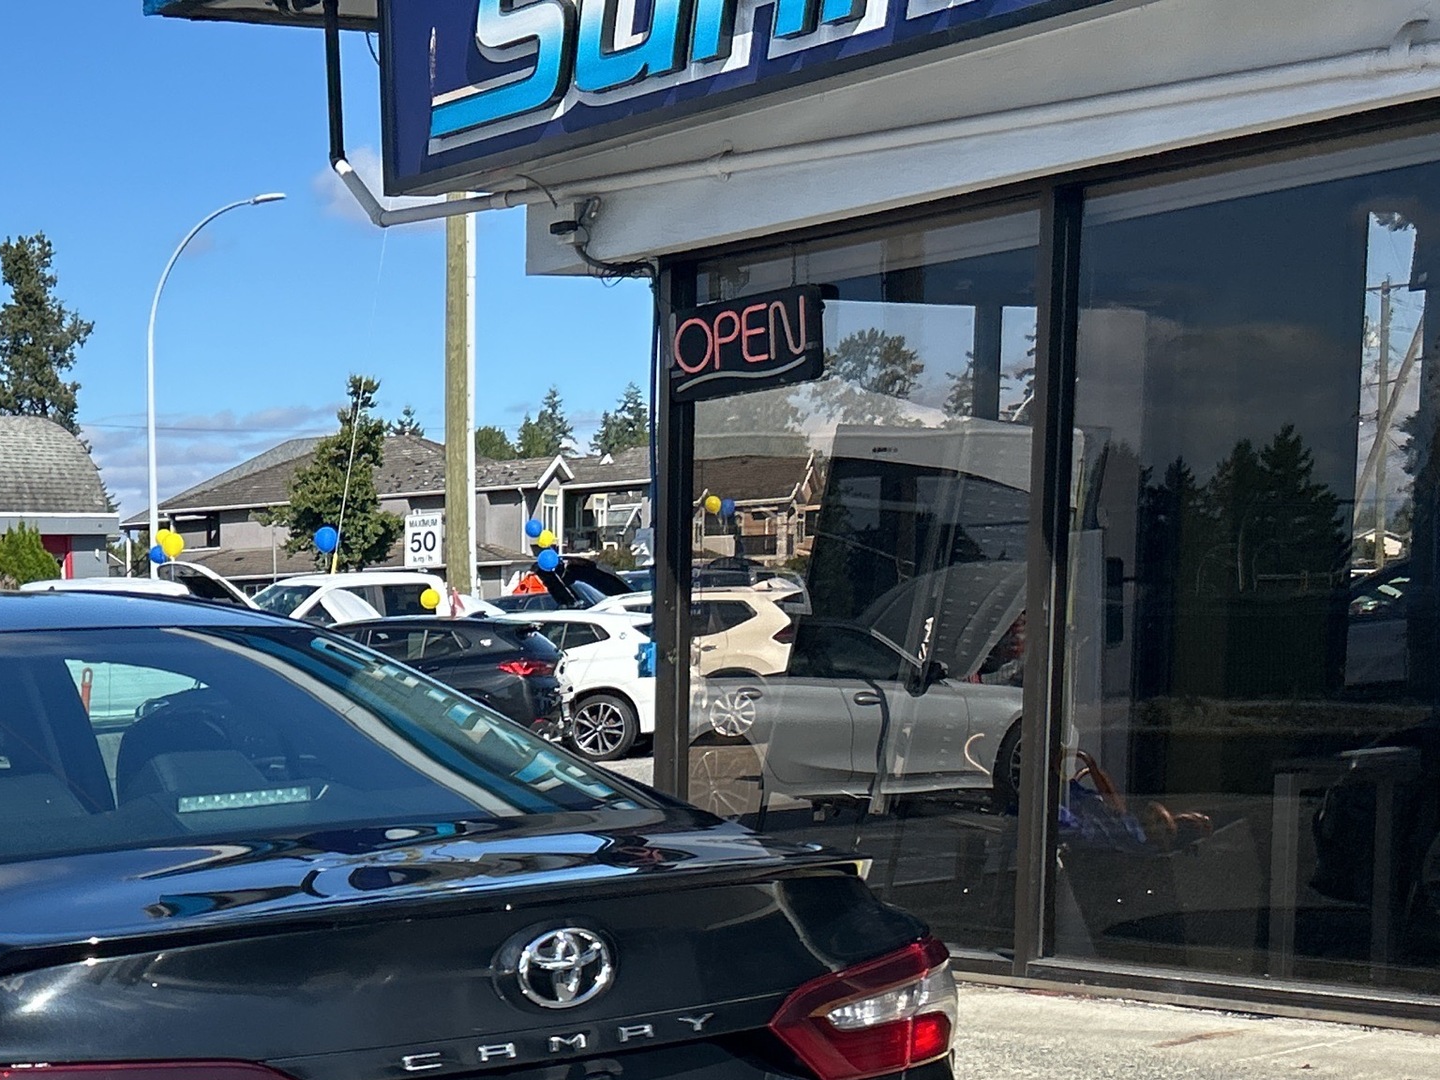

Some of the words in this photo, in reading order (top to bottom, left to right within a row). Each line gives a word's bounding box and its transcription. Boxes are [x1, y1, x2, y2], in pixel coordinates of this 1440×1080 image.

[674, 294, 807, 374] OPEN
[410, 530, 436, 553] 50
[402, 1012, 714, 1071] CAMRY
